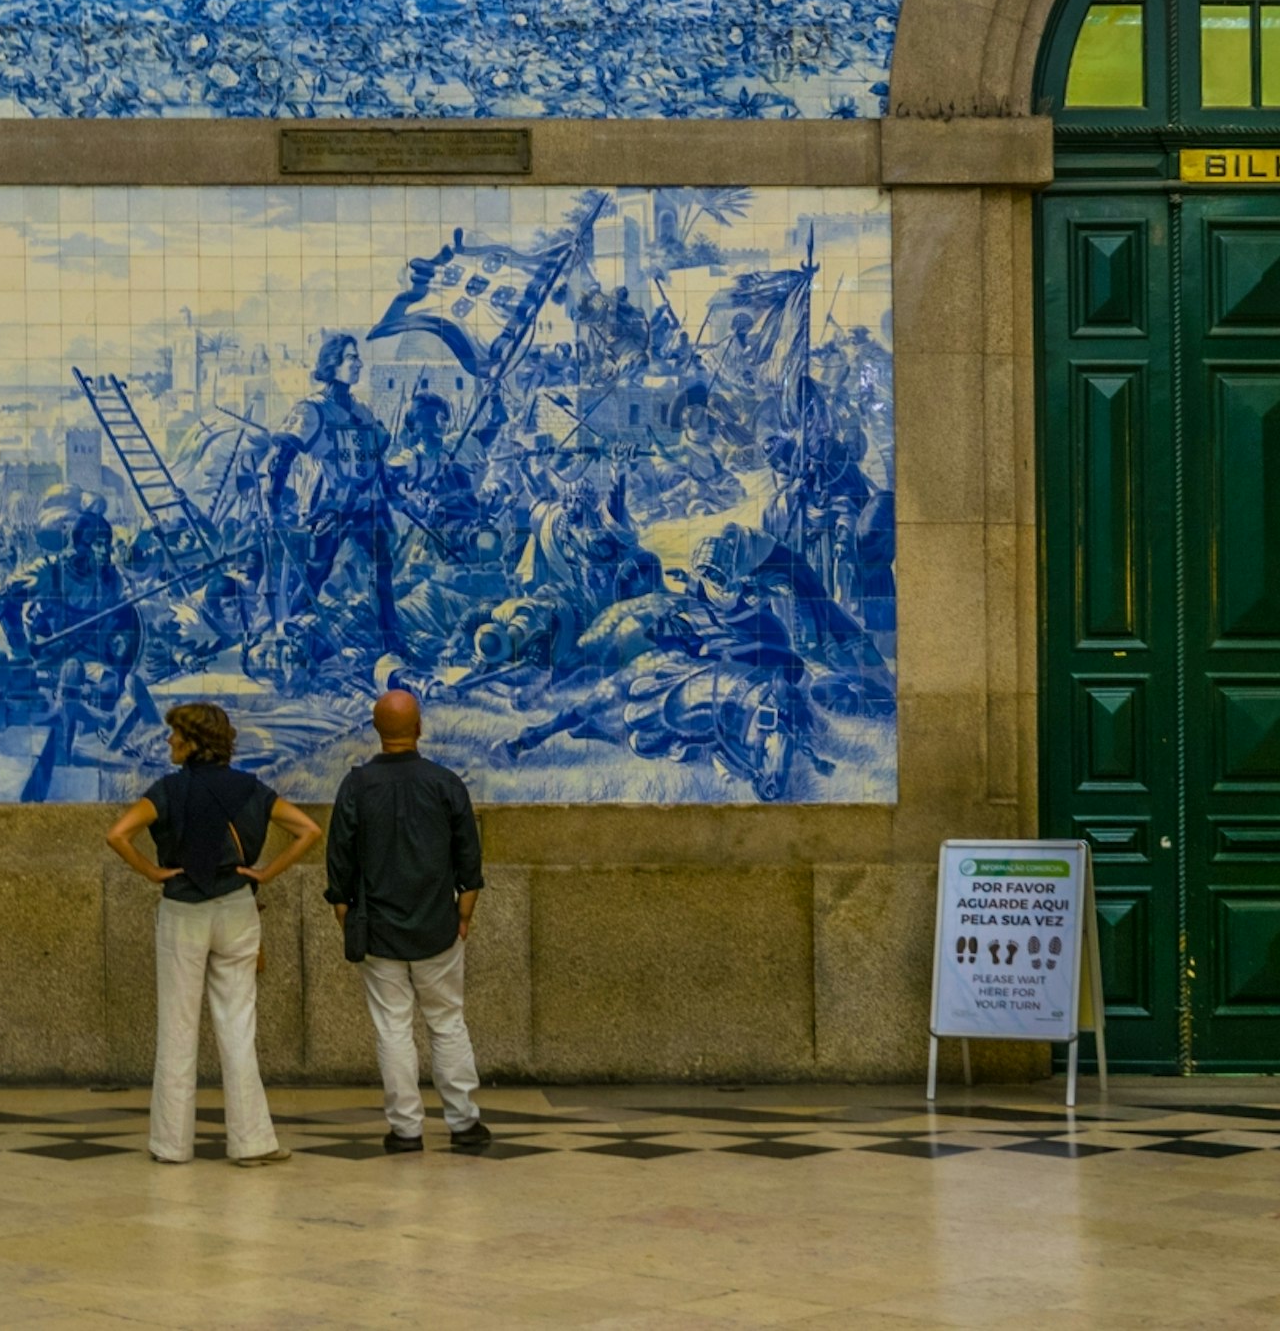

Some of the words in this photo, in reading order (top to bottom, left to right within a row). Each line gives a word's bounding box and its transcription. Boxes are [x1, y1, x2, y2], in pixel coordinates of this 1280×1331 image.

[972, 882, 1002, 893] POR
[1006, 883, 1056, 894] FAVOR
[956, 898, 1029, 910] AGUARDE
[1032, 899, 1070, 912] AQUI
[961, 914, 997, 925] PELA
[1001, 915, 1031, 926] SUA
[1035, 915, 1064, 927] VEZ
[972, 974, 1015, 984] PLEASE
[1017, 975, 1047, 984] WAIT
[978, 987, 1009, 997] HERE
[1012, 988, 1036, 997] FOR
[975, 1000, 1007, 1010] YOUR
[1010, 1000, 1041, 1011] TURN
